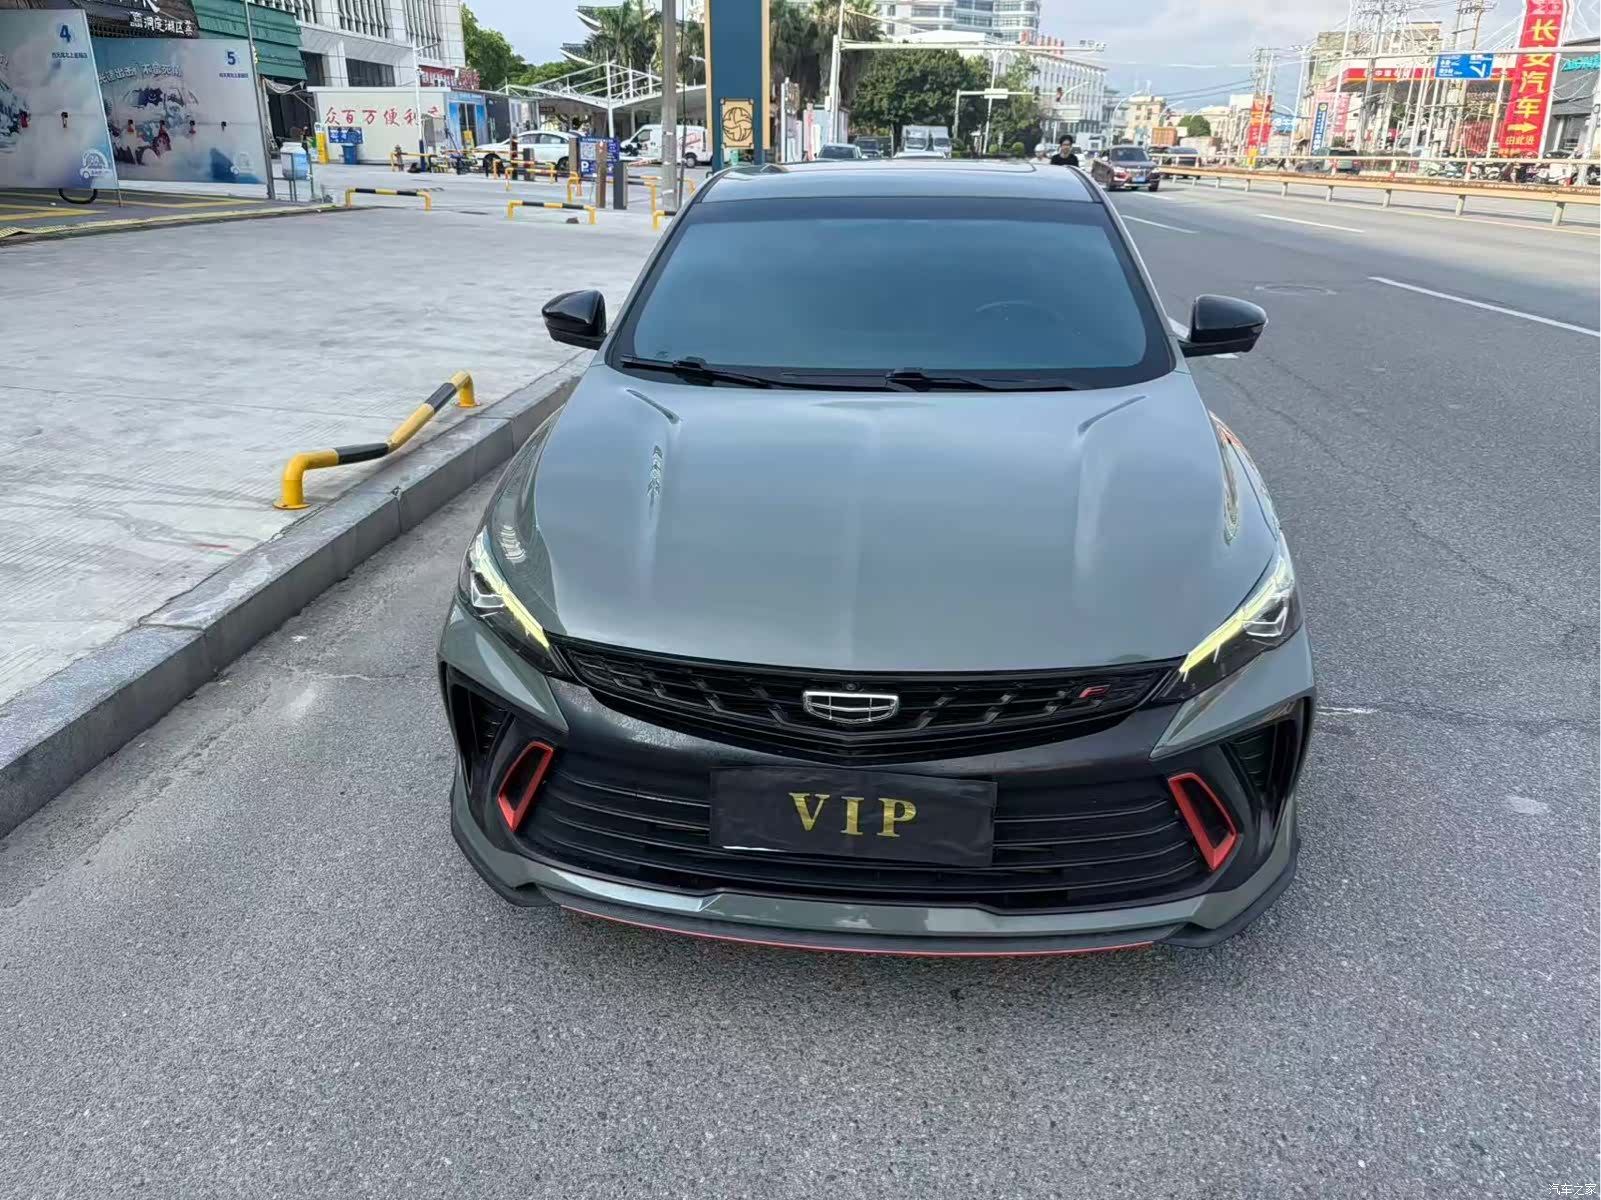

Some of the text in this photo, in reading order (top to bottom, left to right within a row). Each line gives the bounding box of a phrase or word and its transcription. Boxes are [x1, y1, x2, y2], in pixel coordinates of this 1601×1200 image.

[60, 25, 71, 43] 4
[227, 51, 236, 65] 5
[1513, 18, 1560, 119] 长安汽车
[788, 792, 917, 837] VIP
